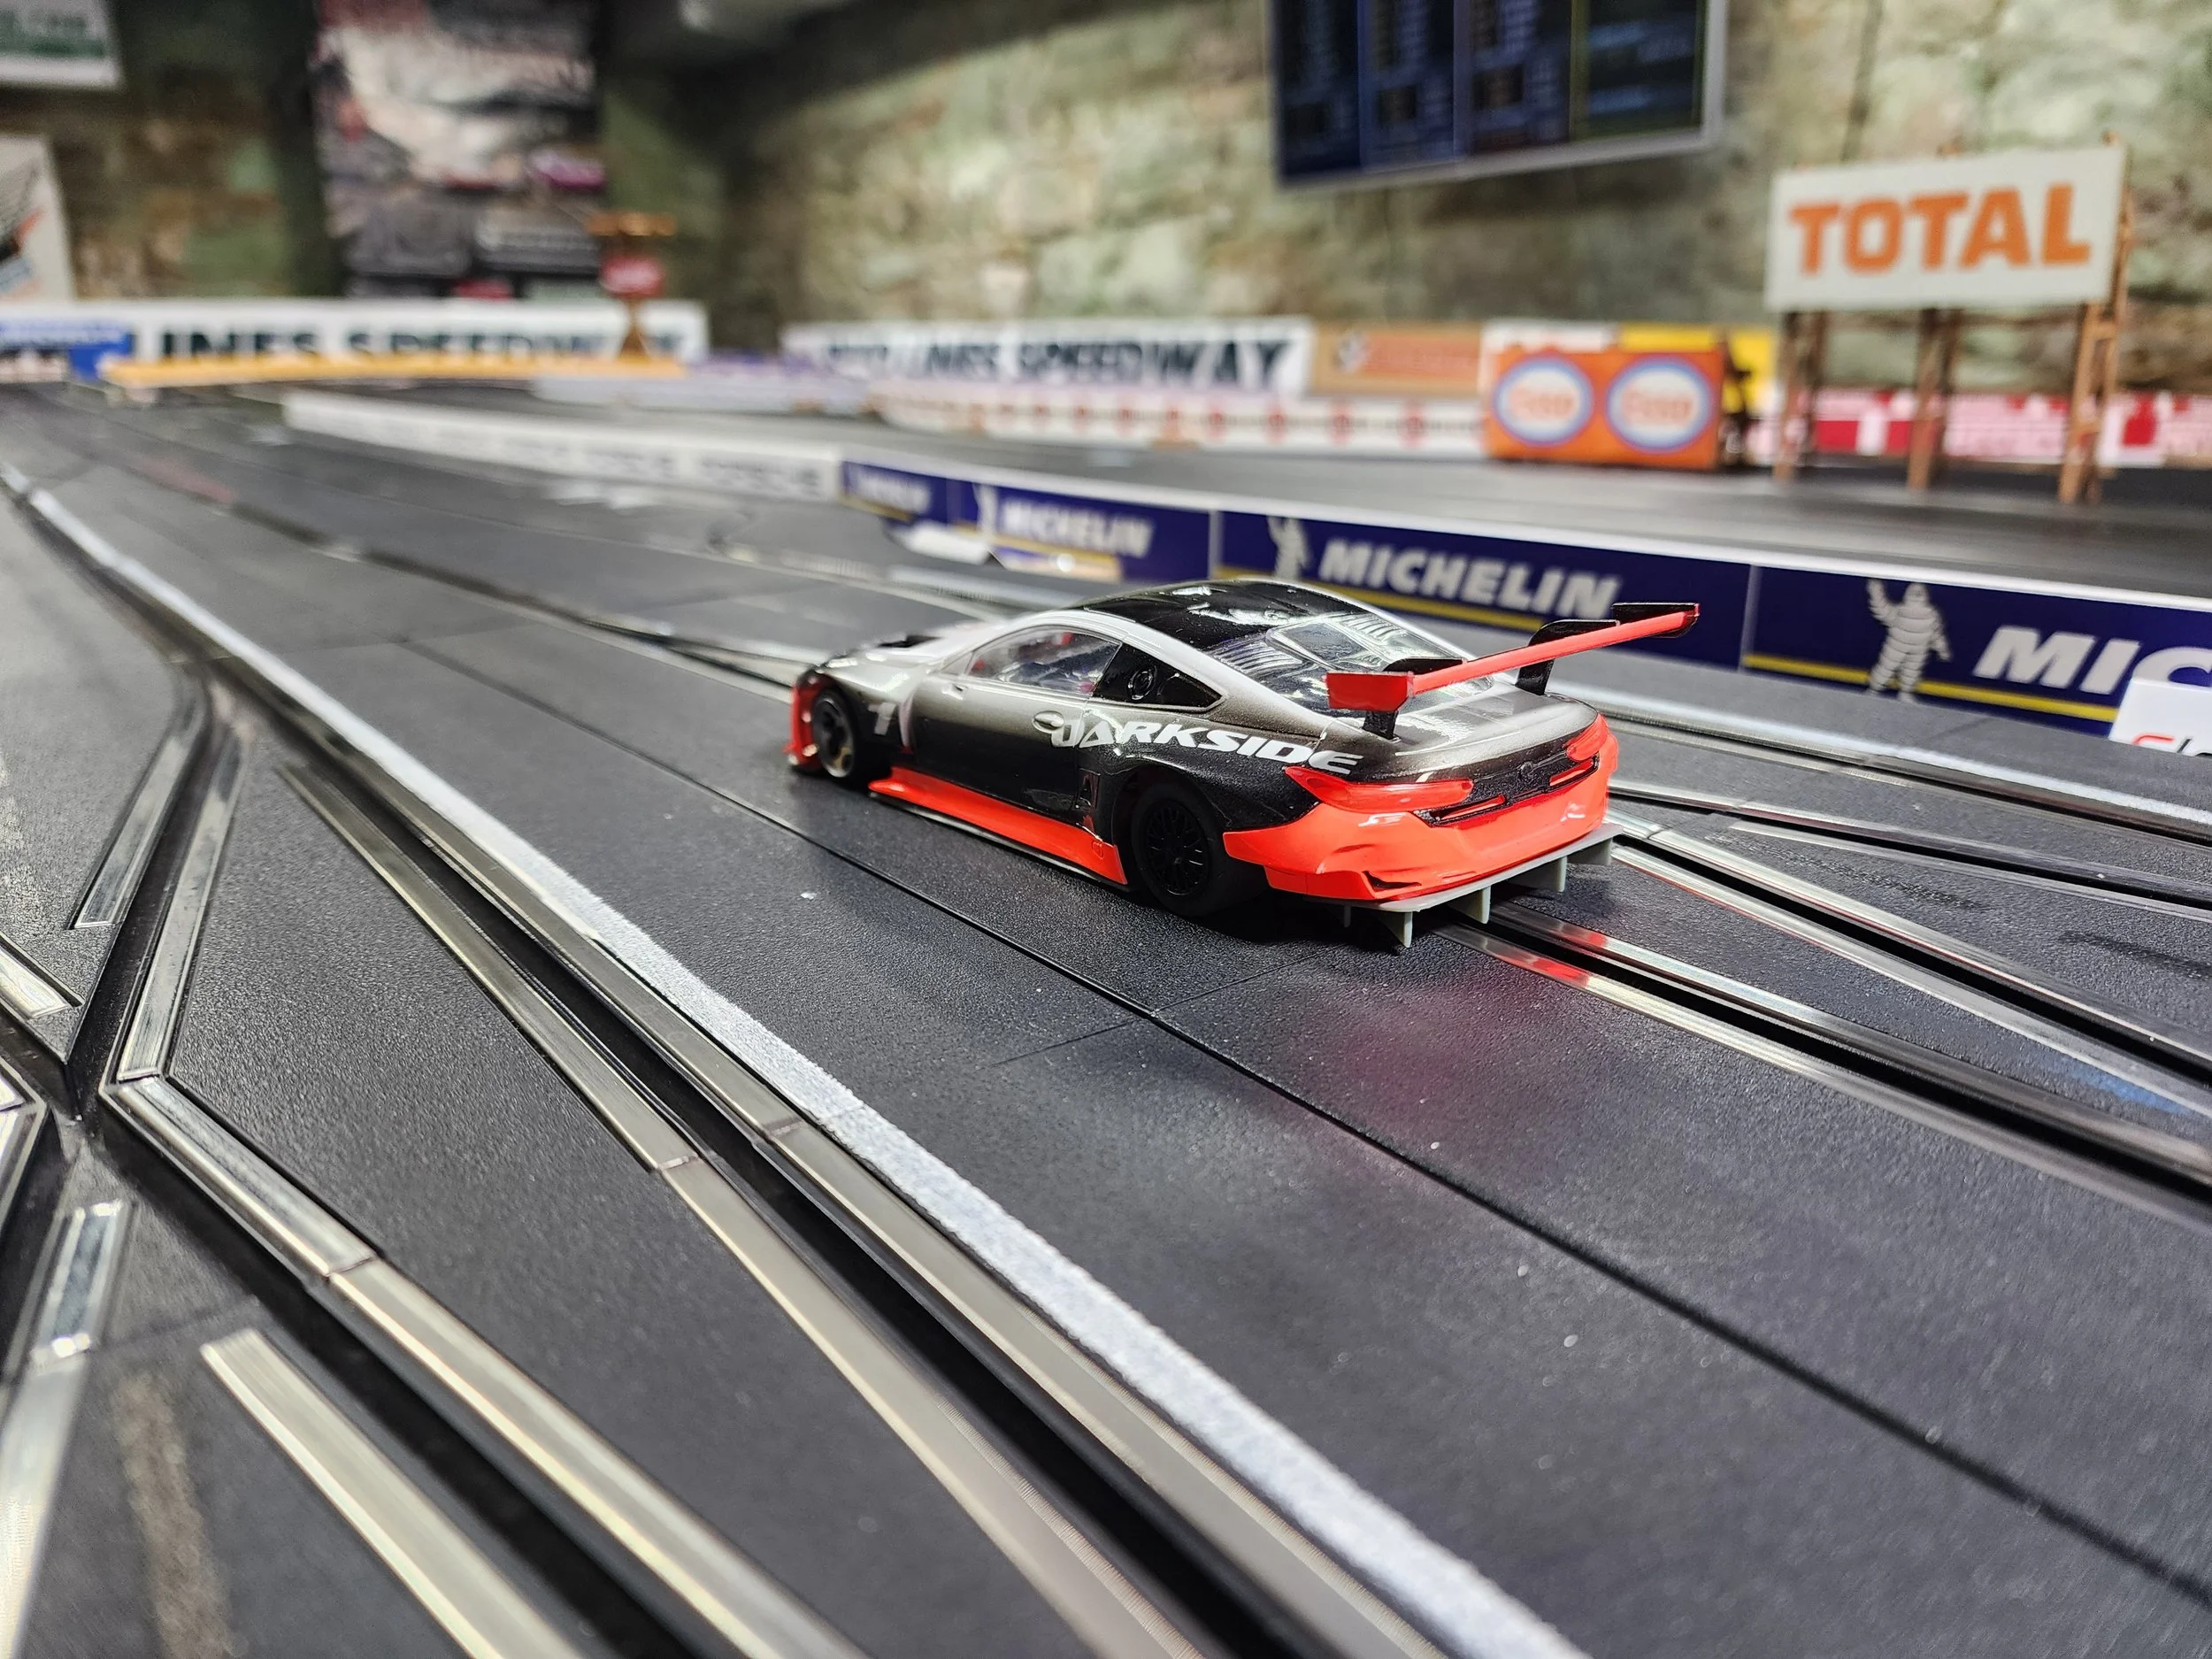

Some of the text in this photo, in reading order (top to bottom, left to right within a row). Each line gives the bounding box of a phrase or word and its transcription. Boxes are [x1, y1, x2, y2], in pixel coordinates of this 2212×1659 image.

[1792, 182, 2091, 275] TOTAL
[1019, 340, 1292, 384] SPEEDWAY
[1002, 498, 1152, 558] MICHELIN
[1318, 537, 1620, 620] MICHELIN
[1051, 719, 1364, 775] DARKSIDE
